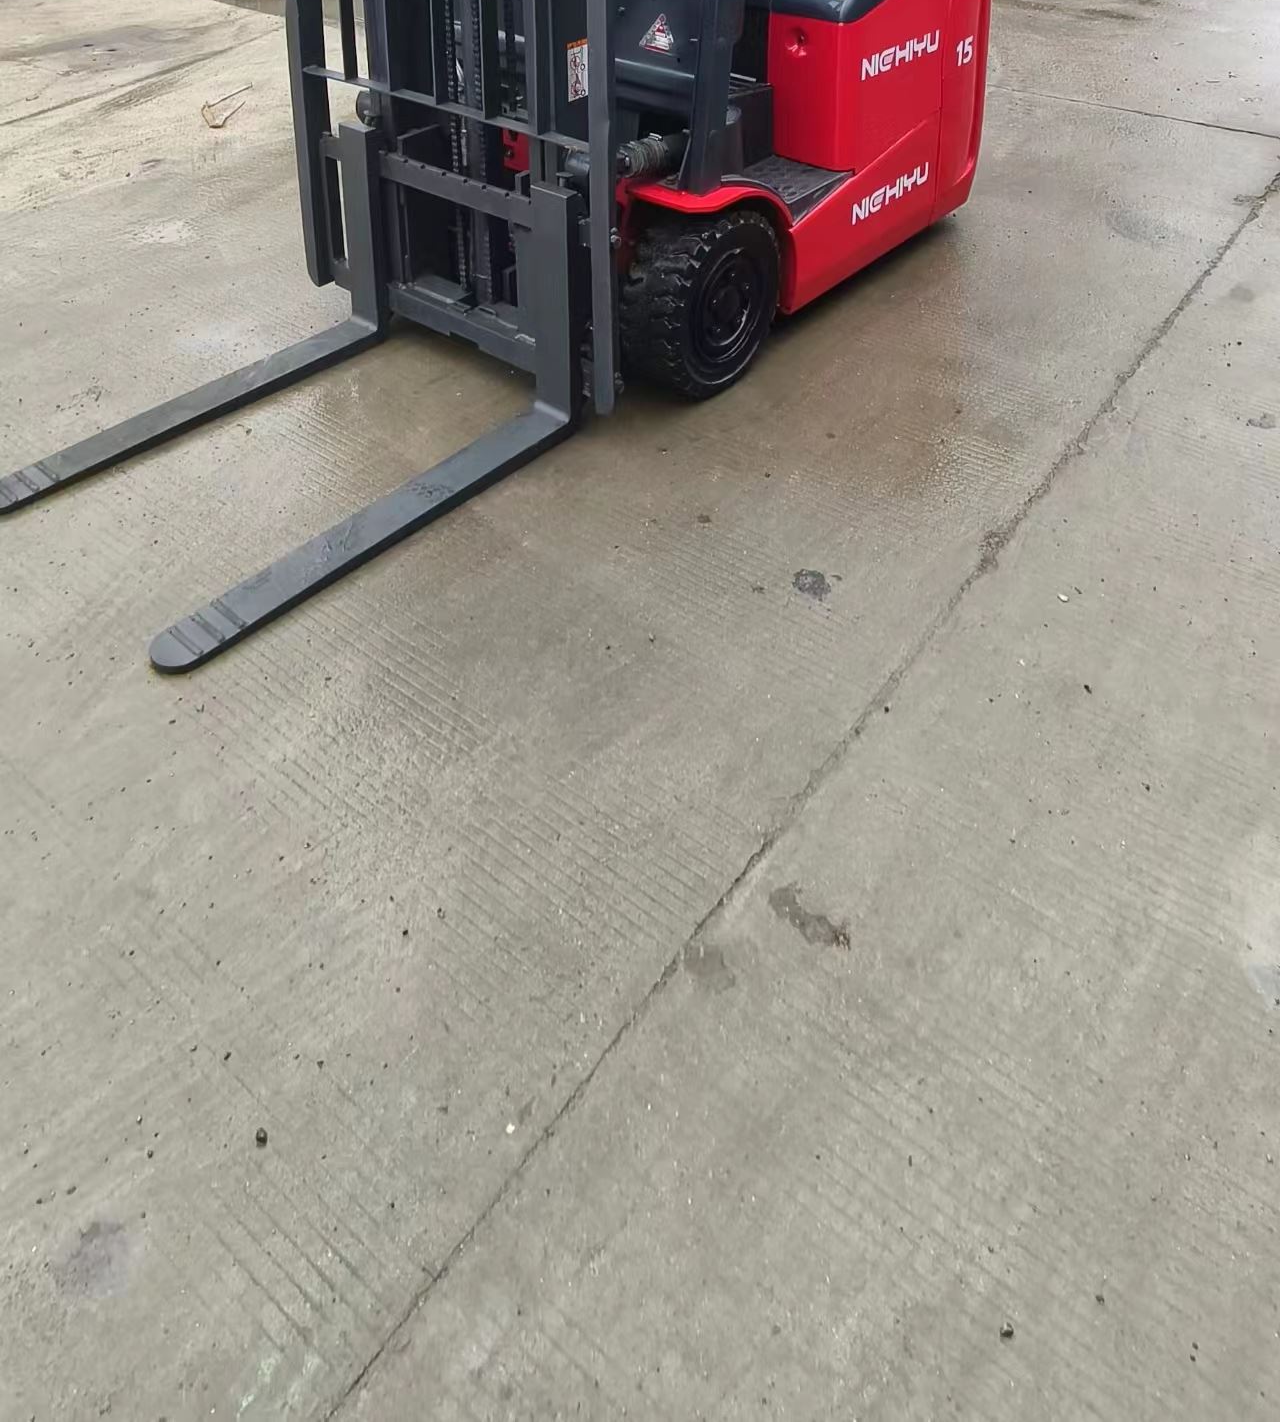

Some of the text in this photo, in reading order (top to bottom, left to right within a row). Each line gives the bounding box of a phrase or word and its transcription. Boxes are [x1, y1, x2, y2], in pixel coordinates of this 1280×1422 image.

[861, 30, 940, 81] NICHIYU
[956, 35, 974, 67] 15
[851, 162, 930, 226] NICHIYU
